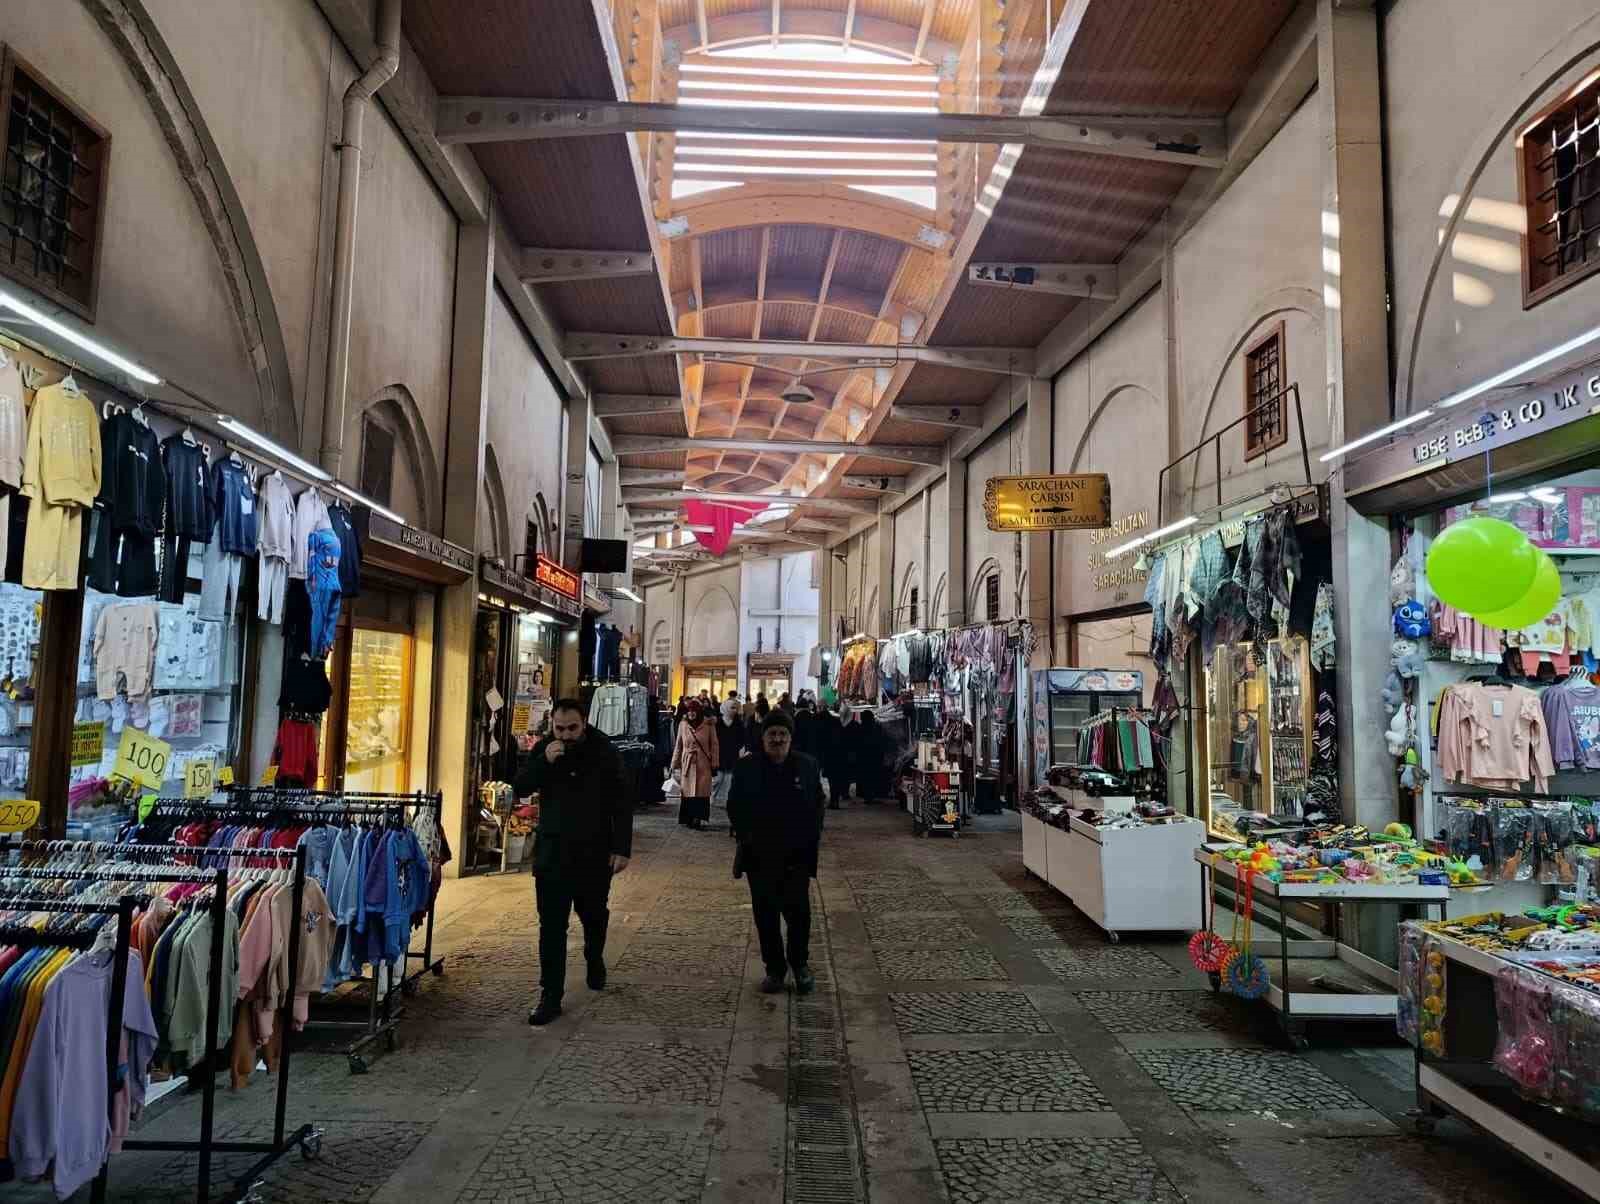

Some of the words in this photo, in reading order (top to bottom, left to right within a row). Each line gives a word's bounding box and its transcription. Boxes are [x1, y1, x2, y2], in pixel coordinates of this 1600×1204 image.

[1519, 400, 1543, 423] CO
[126, 742, 165, 776] 100
[191, 768, 211, 788] 150
[0, 805, 35, 825] 250
